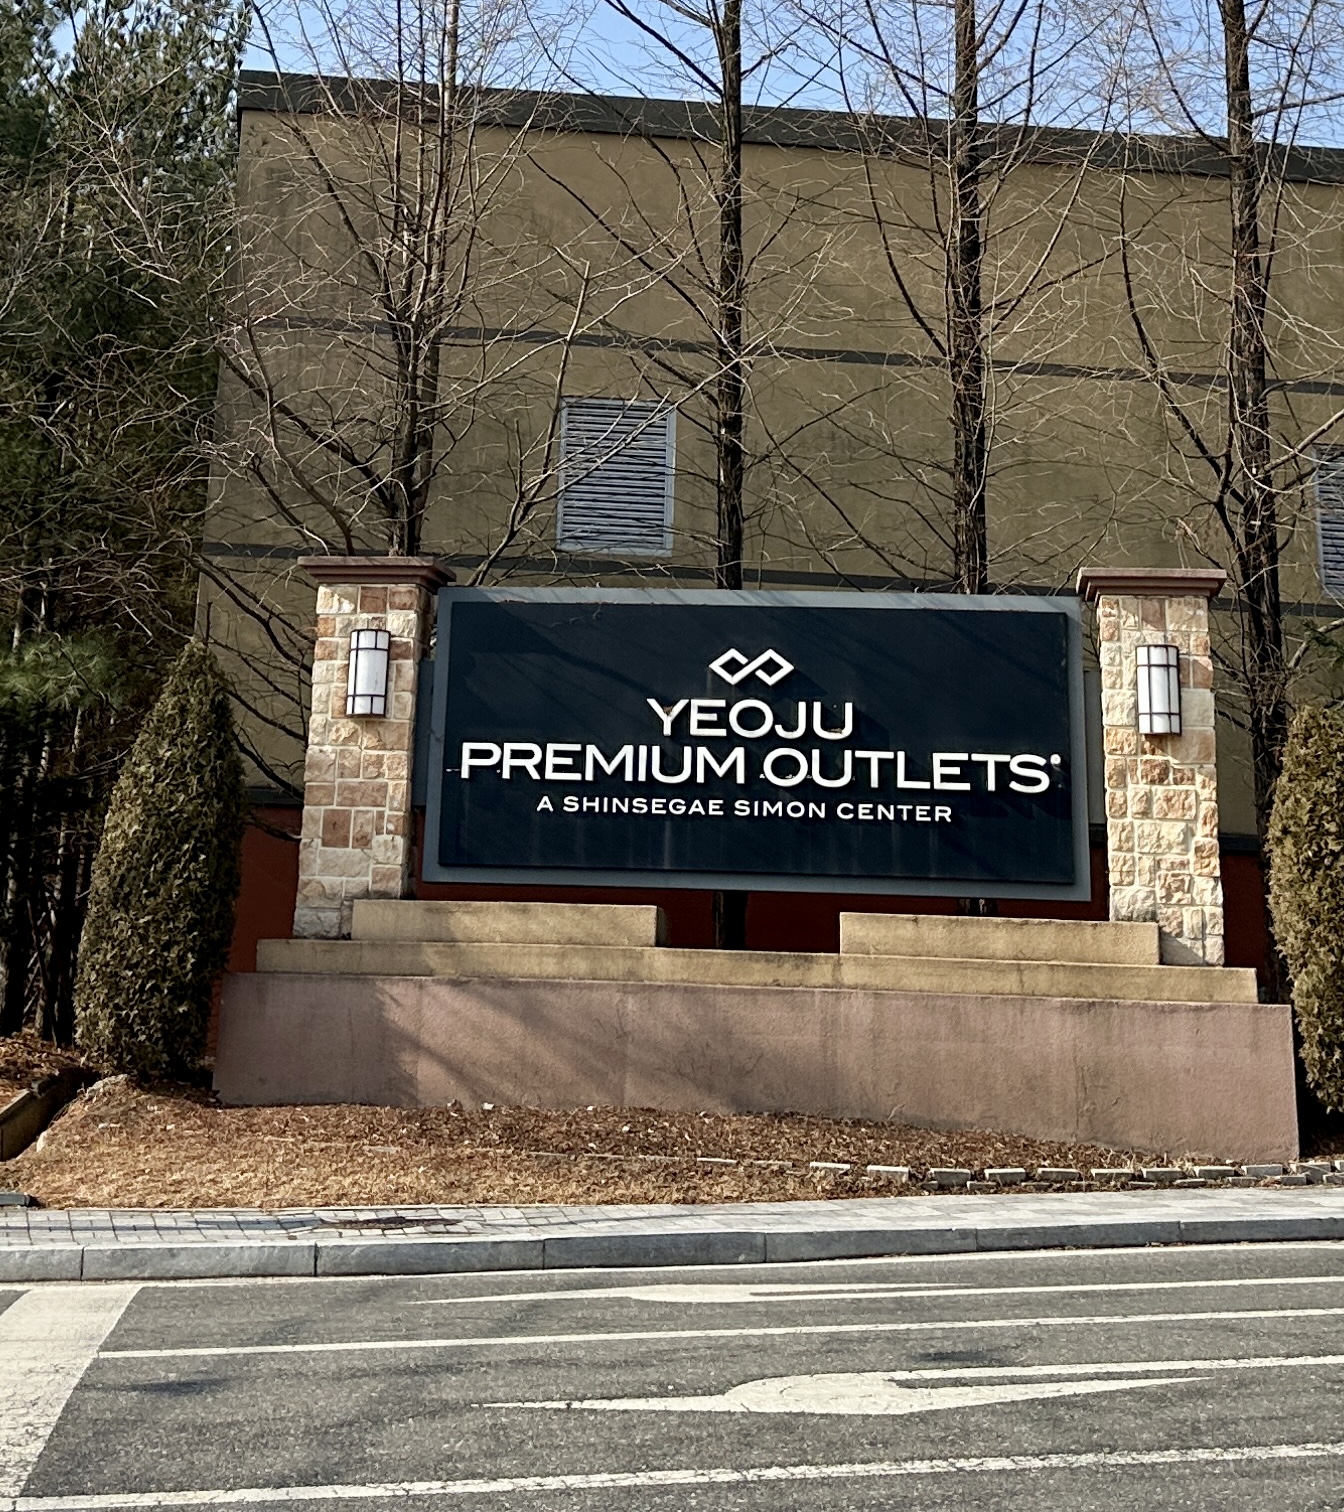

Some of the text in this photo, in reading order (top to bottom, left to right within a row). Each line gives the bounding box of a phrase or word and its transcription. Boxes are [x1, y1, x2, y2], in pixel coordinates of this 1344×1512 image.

[647, 698, 853, 740] YEOJU
[460, 742, 745, 784] PREMIUM
[536, 795, 952, 823] A SHINSEGAE SIMON CENTER
